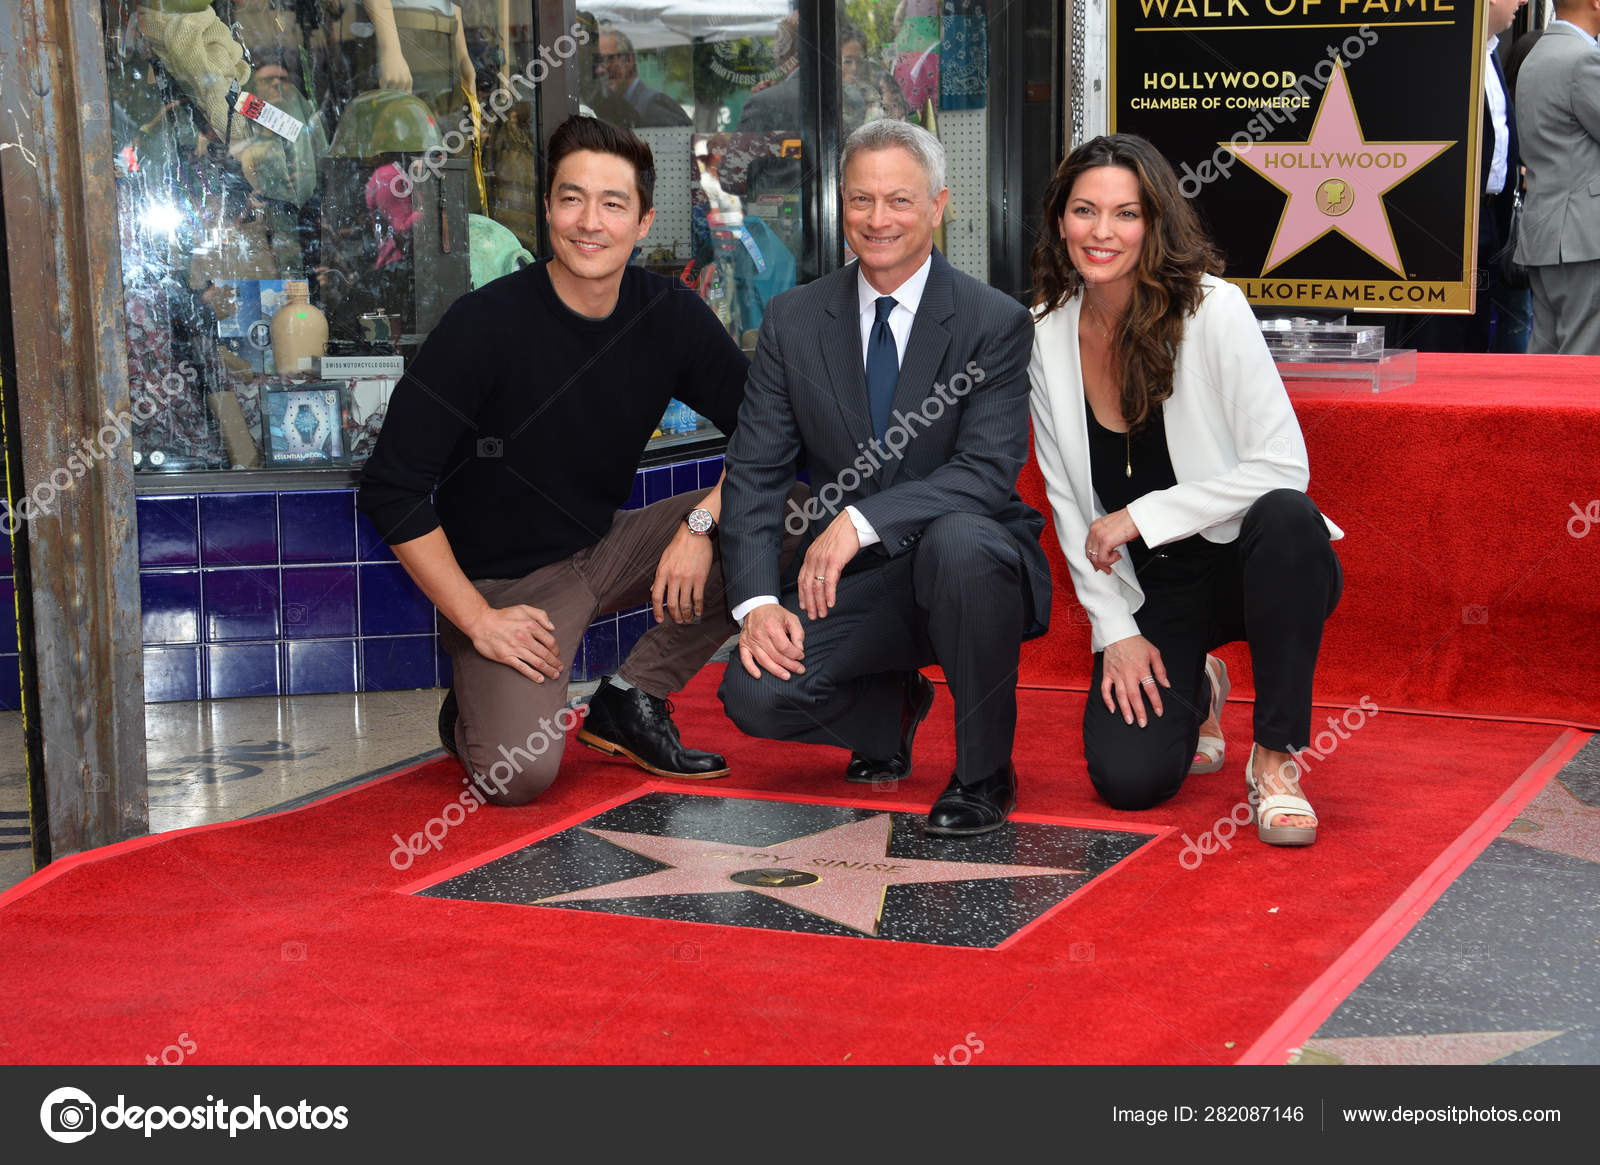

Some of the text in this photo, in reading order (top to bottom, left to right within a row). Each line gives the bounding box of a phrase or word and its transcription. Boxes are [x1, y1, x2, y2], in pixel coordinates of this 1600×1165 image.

[1144, 71, 1297, 90] HOLLYWOOD
[1130, 96, 1311, 110] CHAMBER OF COMMERCE
[1264, 152, 1408, 169] HOLLYWOOD
[1236, 283, 1446, 303] LKOFFAME.COM
[805, 857, 912, 874] SINISE
